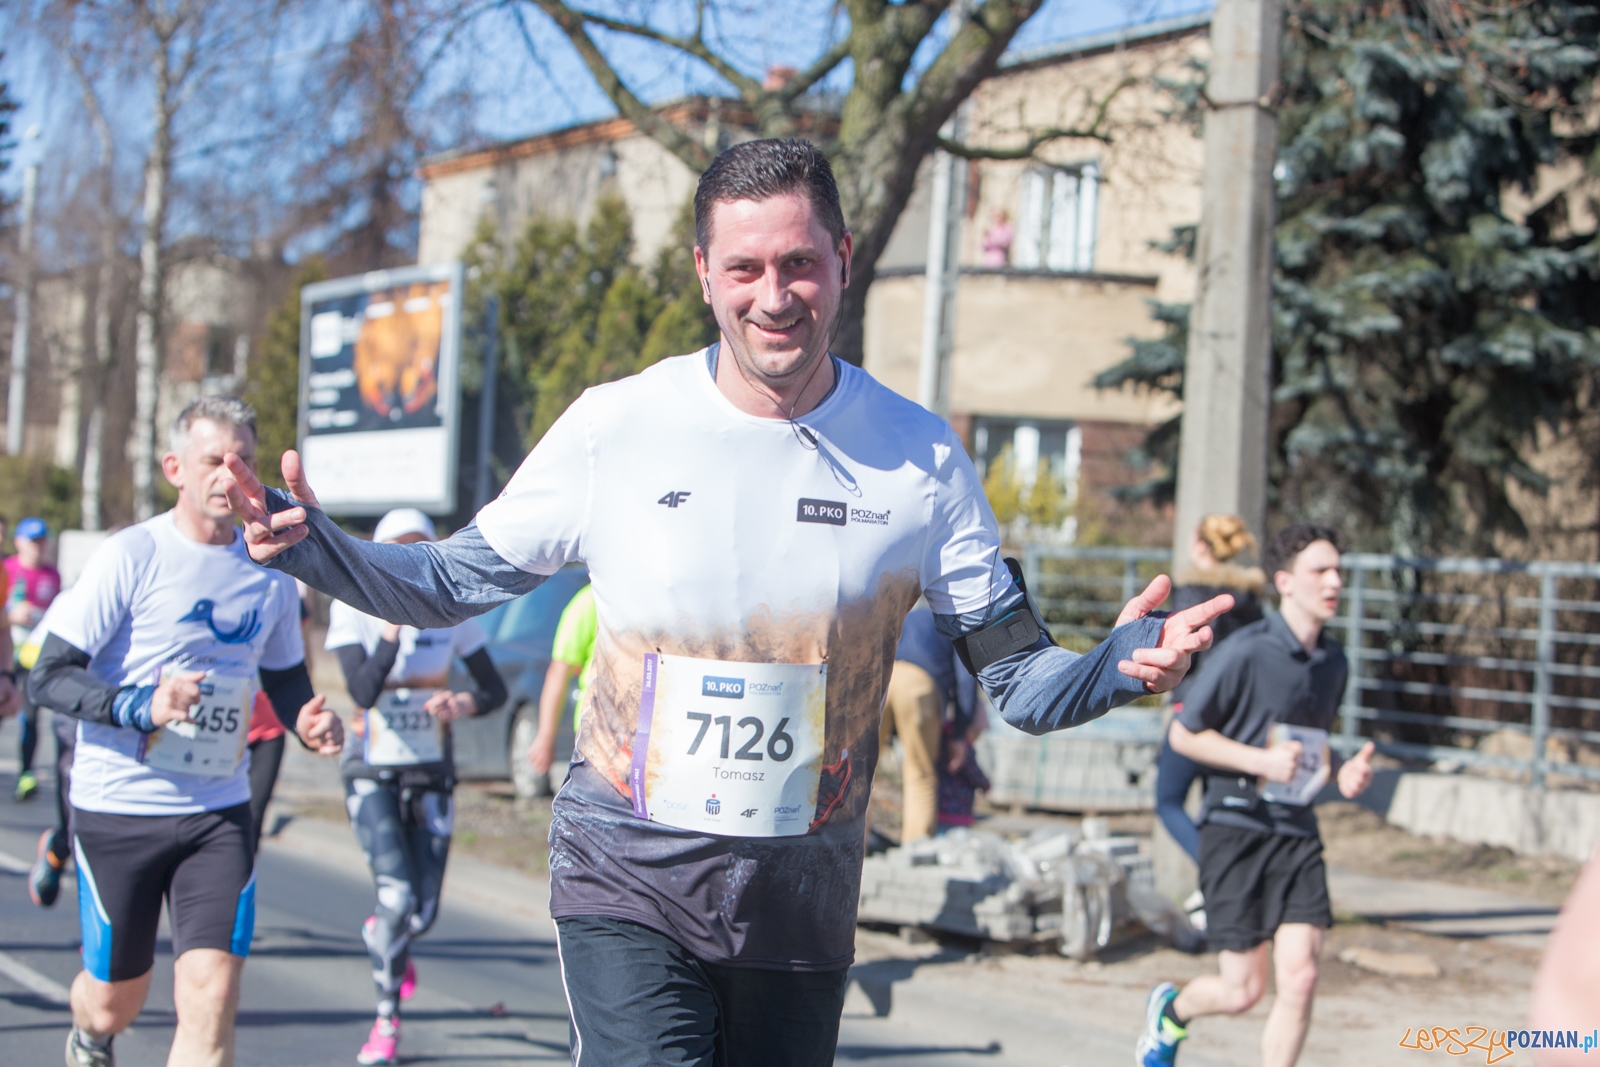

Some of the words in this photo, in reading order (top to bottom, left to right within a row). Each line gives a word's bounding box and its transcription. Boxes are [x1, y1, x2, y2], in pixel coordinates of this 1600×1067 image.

[657, 490, 692, 508] 4F
[802, 504, 818, 516] 10.
[819, 505, 844, 519] PKO
[719, 681, 742, 694] PKO
[174, 705, 240, 734] 455
[686, 711, 794, 762] 7126
[712, 766, 765, 782] Tomasz
